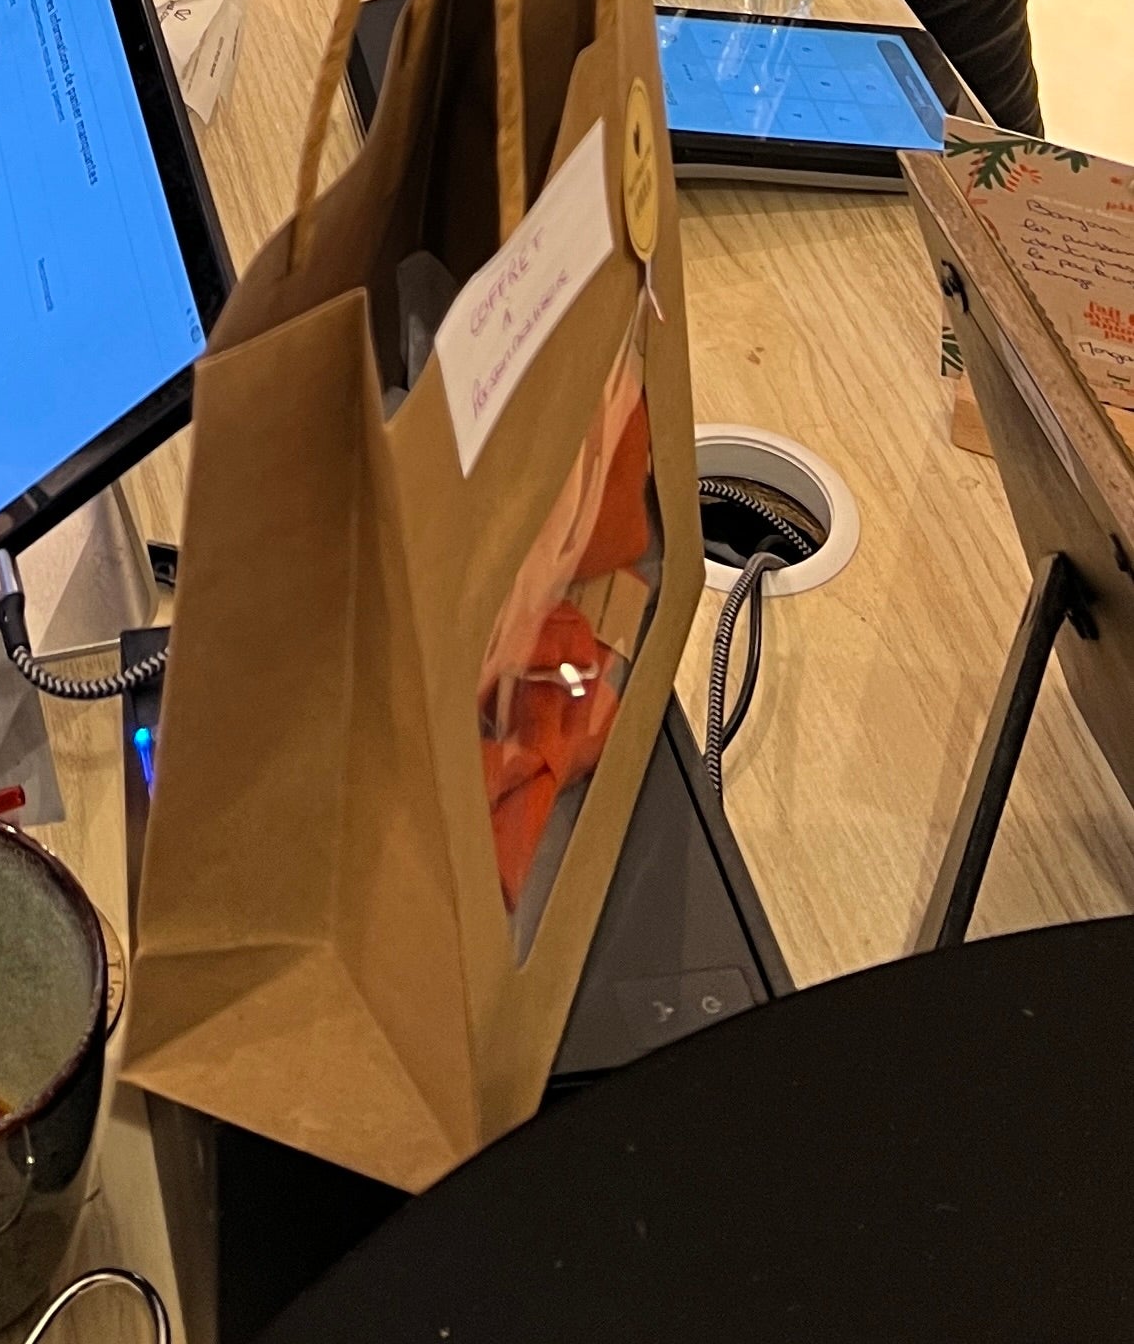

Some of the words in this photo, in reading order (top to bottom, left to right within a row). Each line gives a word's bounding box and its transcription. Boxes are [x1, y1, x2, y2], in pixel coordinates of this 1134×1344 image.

[50, 10, 69, 73] informations
[65, 73, 74, 87] de
[66, 87, 82, 118] panier
[77, 120, 98, 185] manquantes
